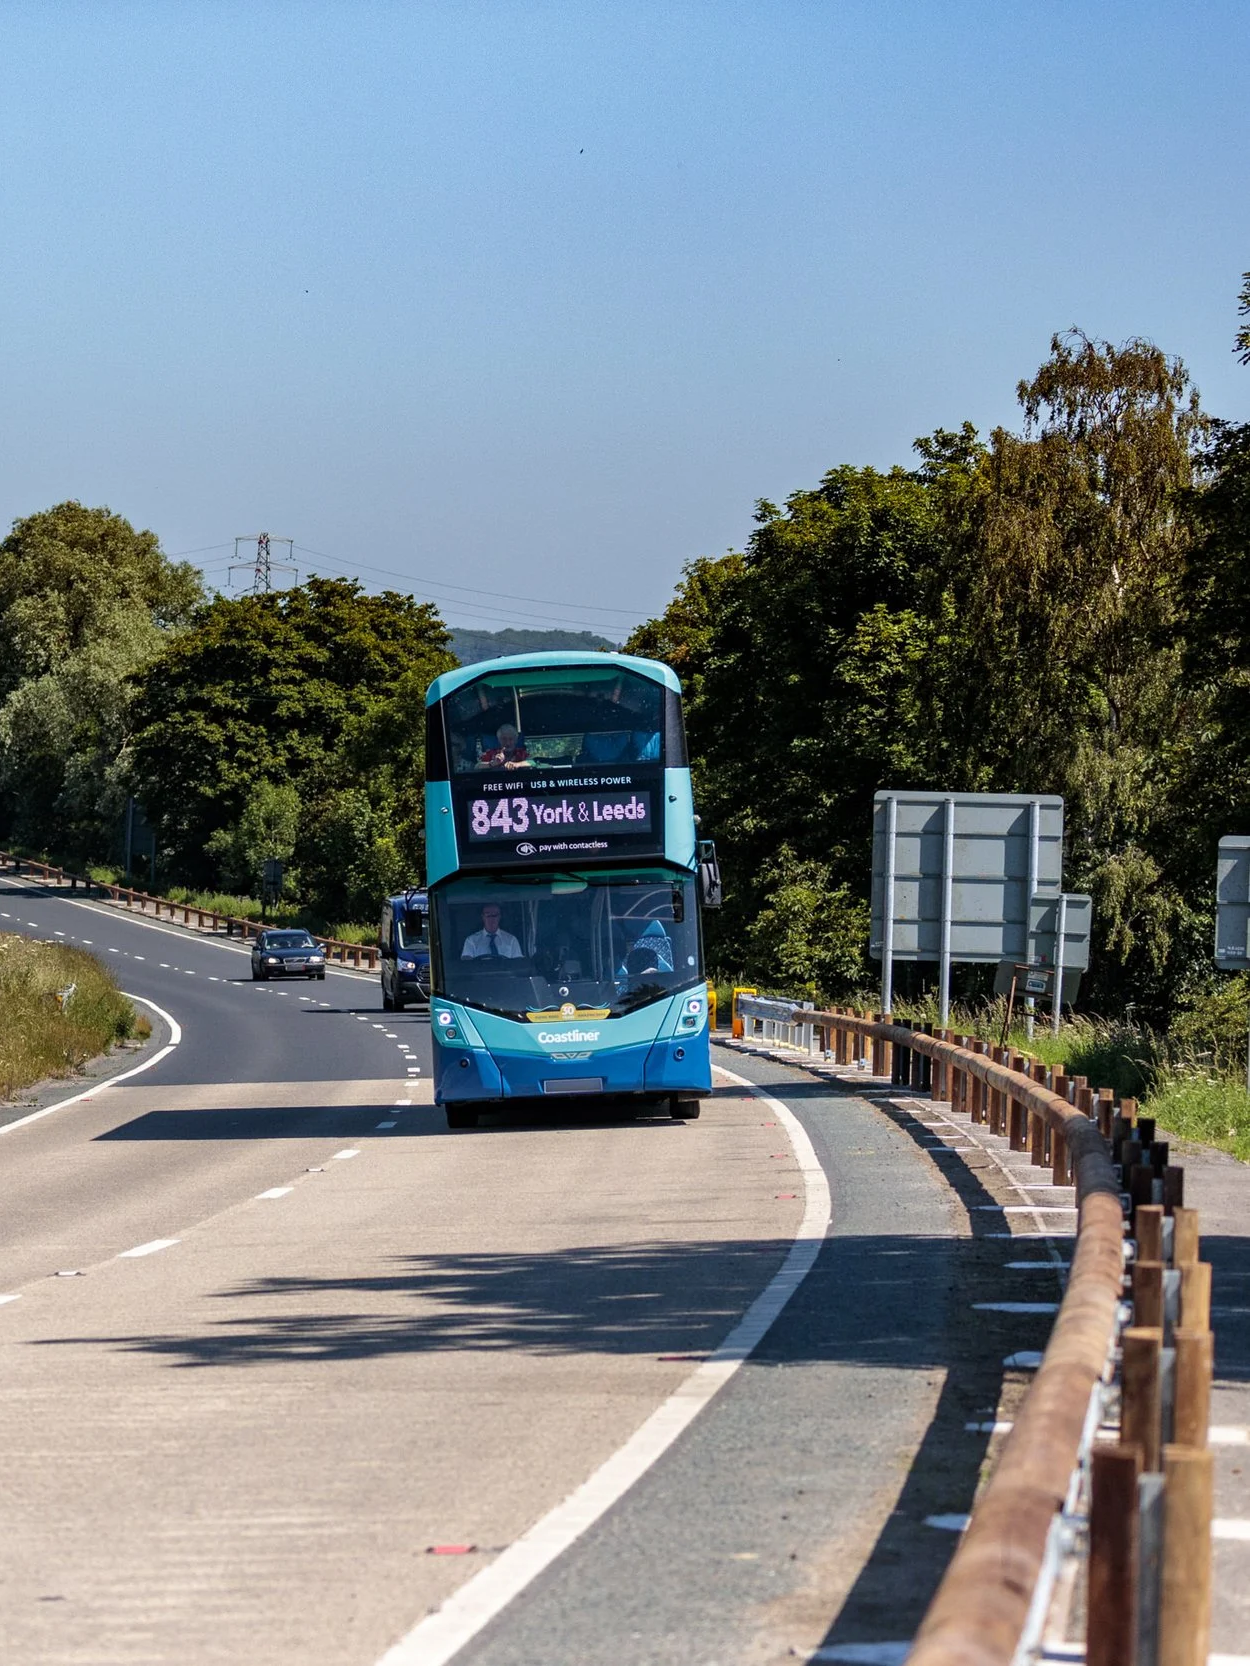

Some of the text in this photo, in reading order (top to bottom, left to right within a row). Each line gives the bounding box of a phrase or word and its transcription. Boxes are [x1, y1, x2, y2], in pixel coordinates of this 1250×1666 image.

[483, 783, 503, 791] FREE
[505, 782, 524, 790] WIFI
[530, 780, 547, 789] USB
[557, 777, 599, 787] WIRELESS
[600, 776, 632, 785] POWER
[471, 796, 646, 836] 843 York & Leeds
[539, 840, 608, 853] pay with contactless
[562, 1006, 574, 1015] 30
[537, 1028, 600, 1044] Coastliner
